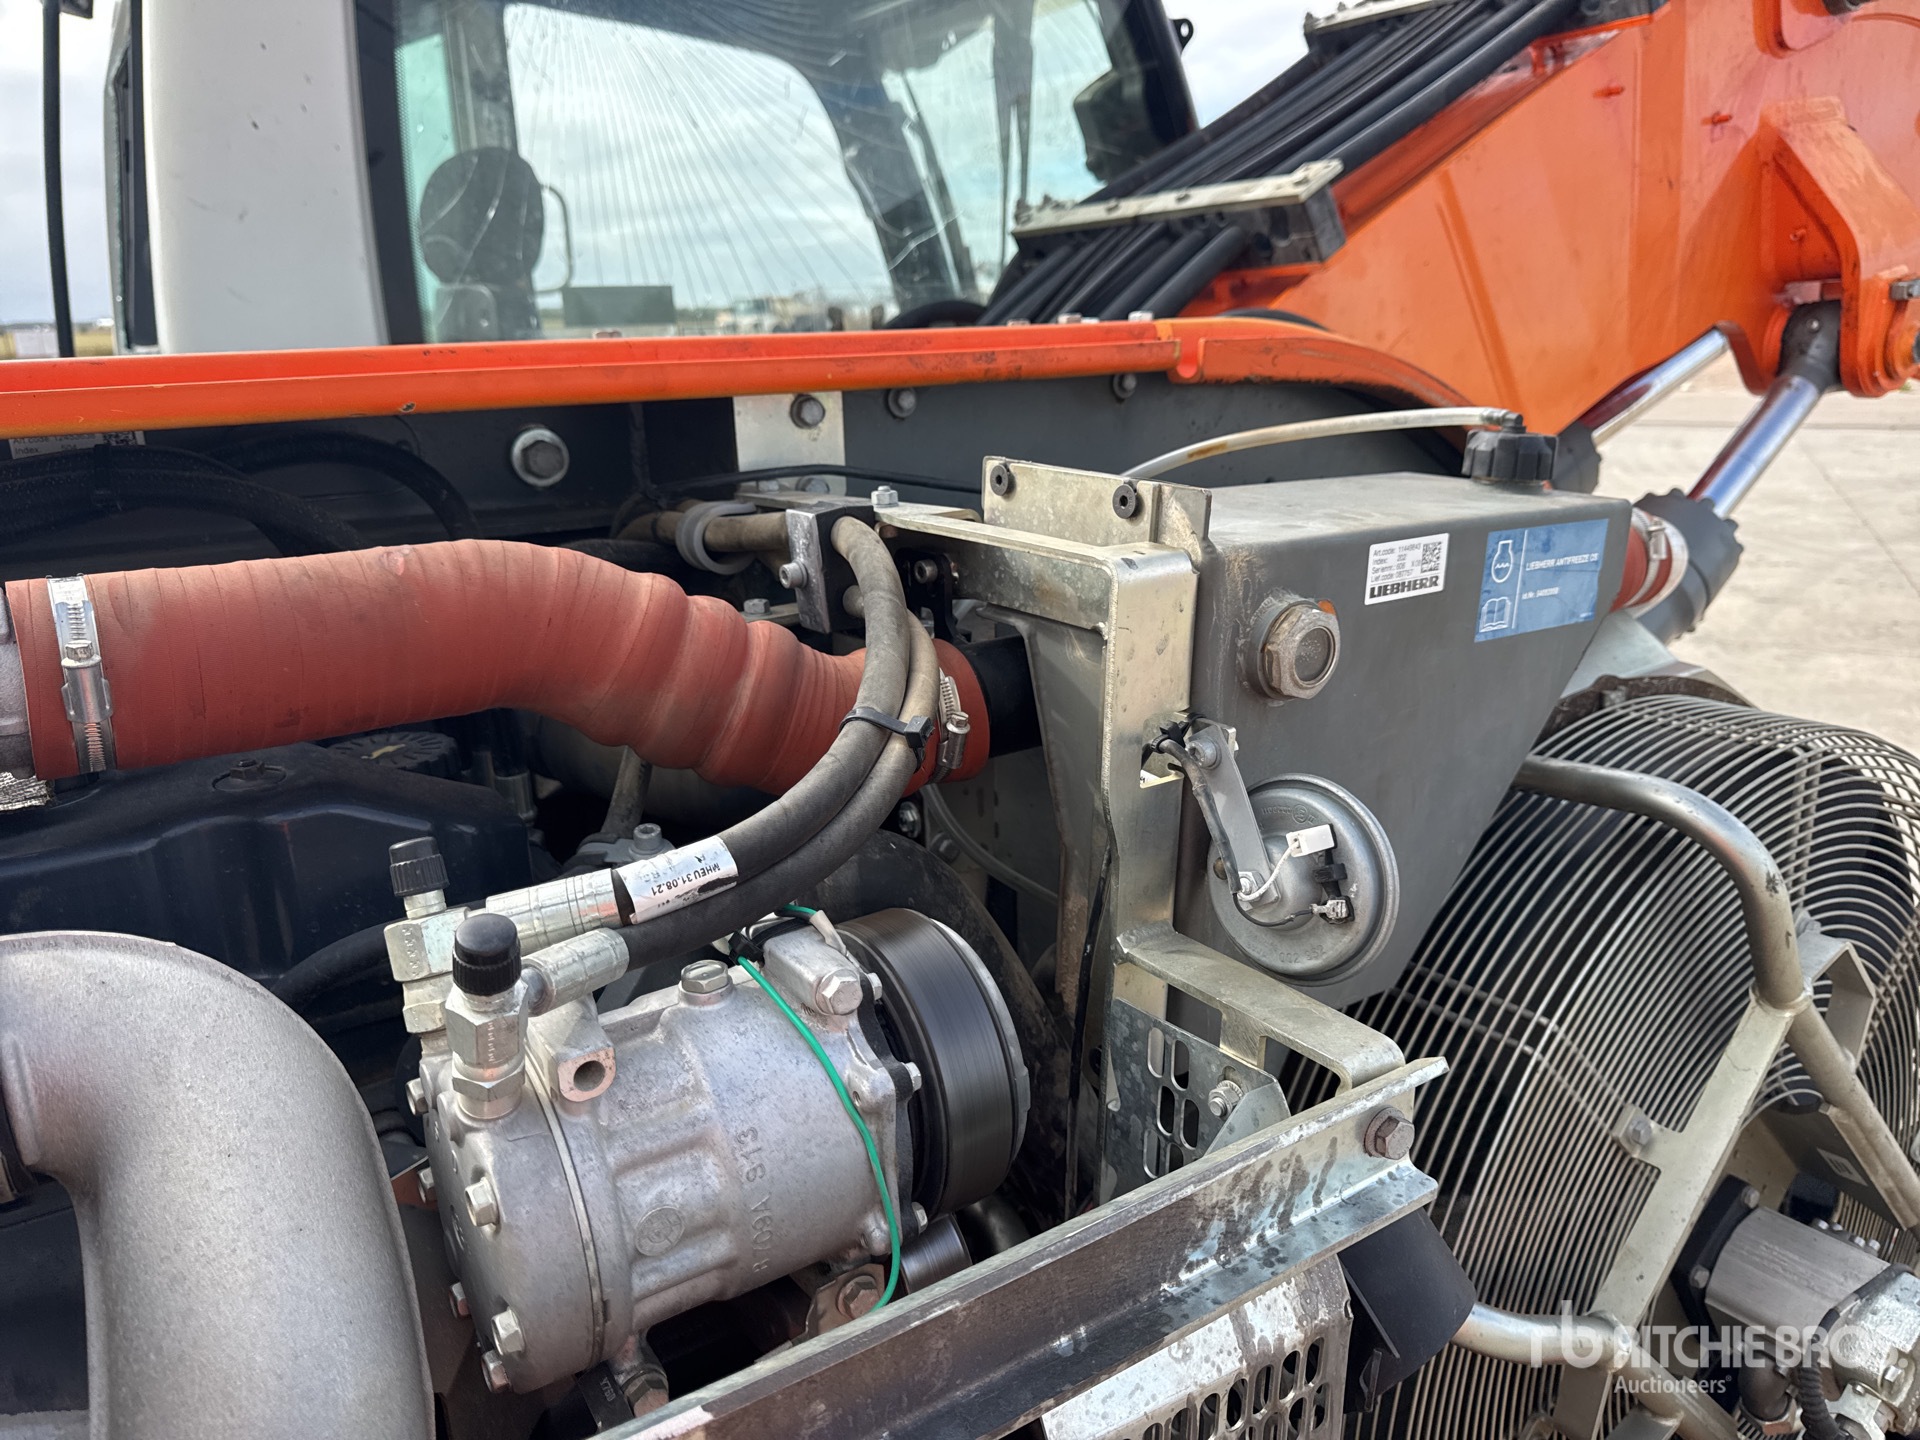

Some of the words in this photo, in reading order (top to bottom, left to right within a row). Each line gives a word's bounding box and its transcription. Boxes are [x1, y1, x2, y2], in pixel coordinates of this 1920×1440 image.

[1525, 558, 1557, 571] LIEBHERR
[1555, 553, 1591, 567] ANTIFREEZE
[1369, 575, 1440, 599] LIEBHERR
